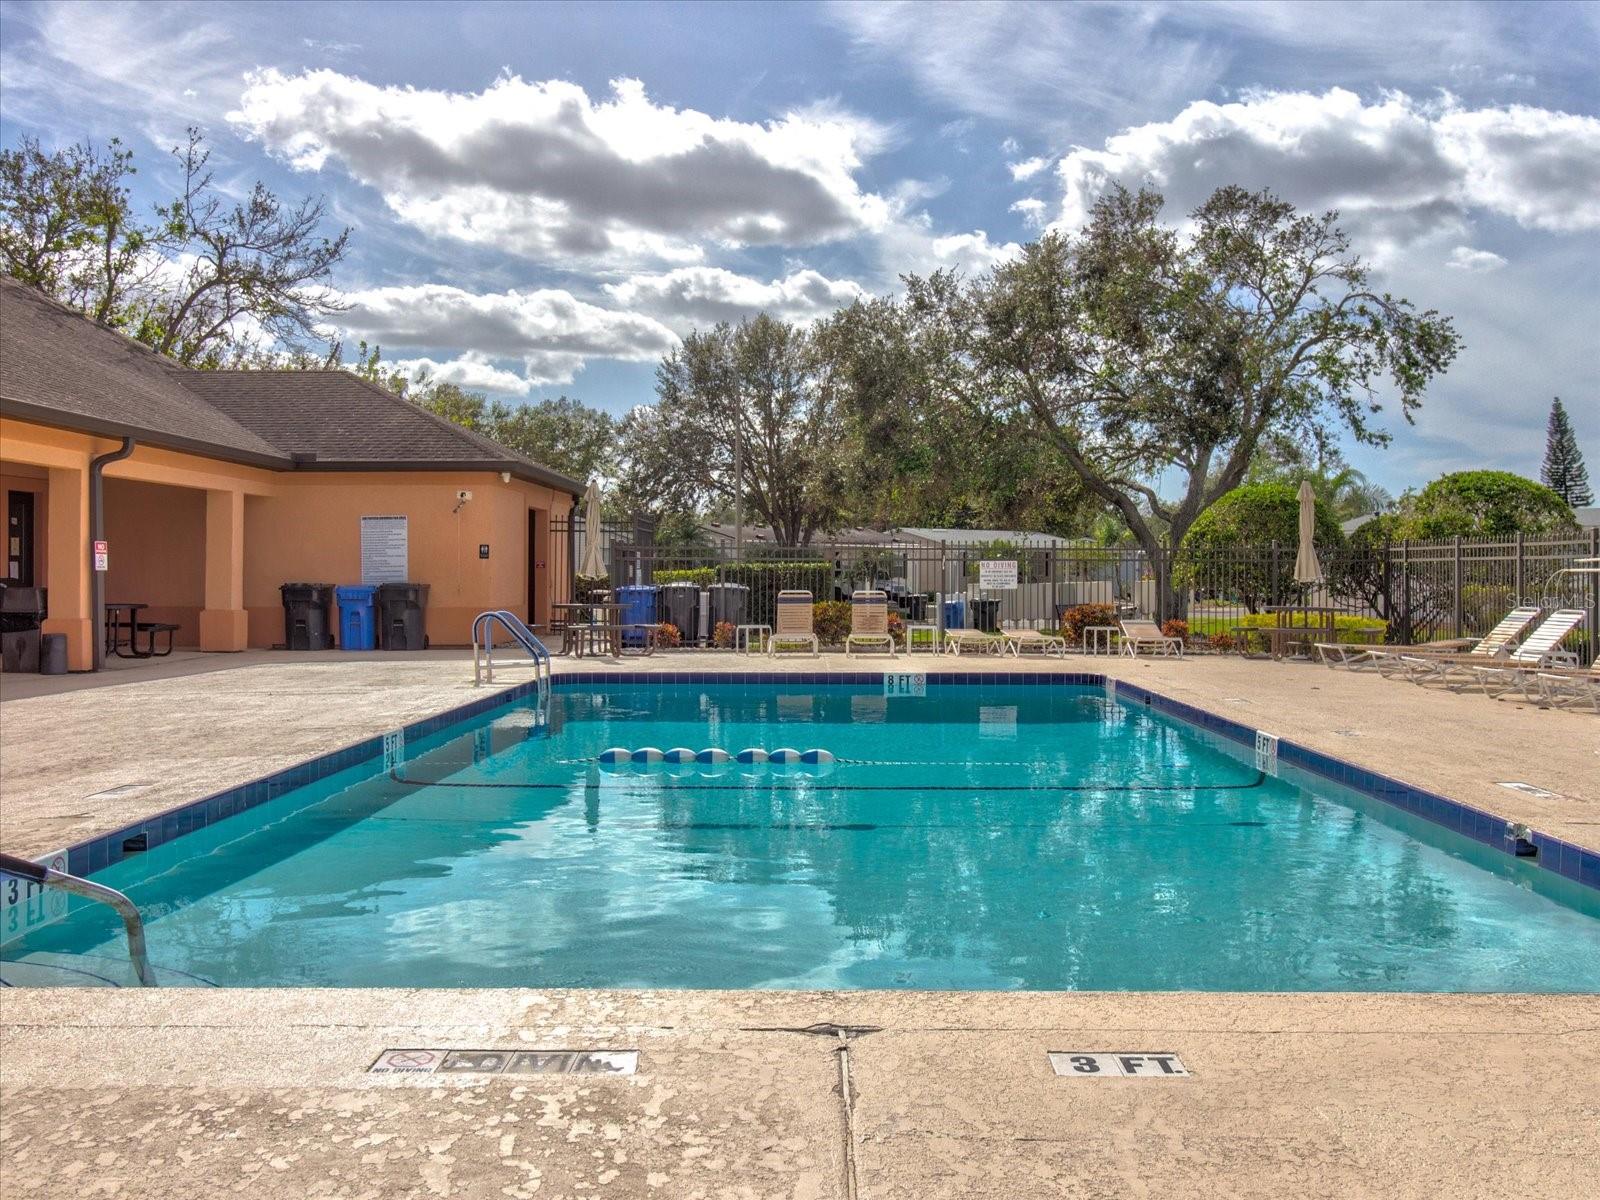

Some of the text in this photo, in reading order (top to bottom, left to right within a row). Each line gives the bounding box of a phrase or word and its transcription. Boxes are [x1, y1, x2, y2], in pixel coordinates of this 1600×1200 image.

[888, 675, 911, 686] 8 FT
[8, 880, 18, 905] 3
[1070, 1056, 1183, 1074] 3 FT.
